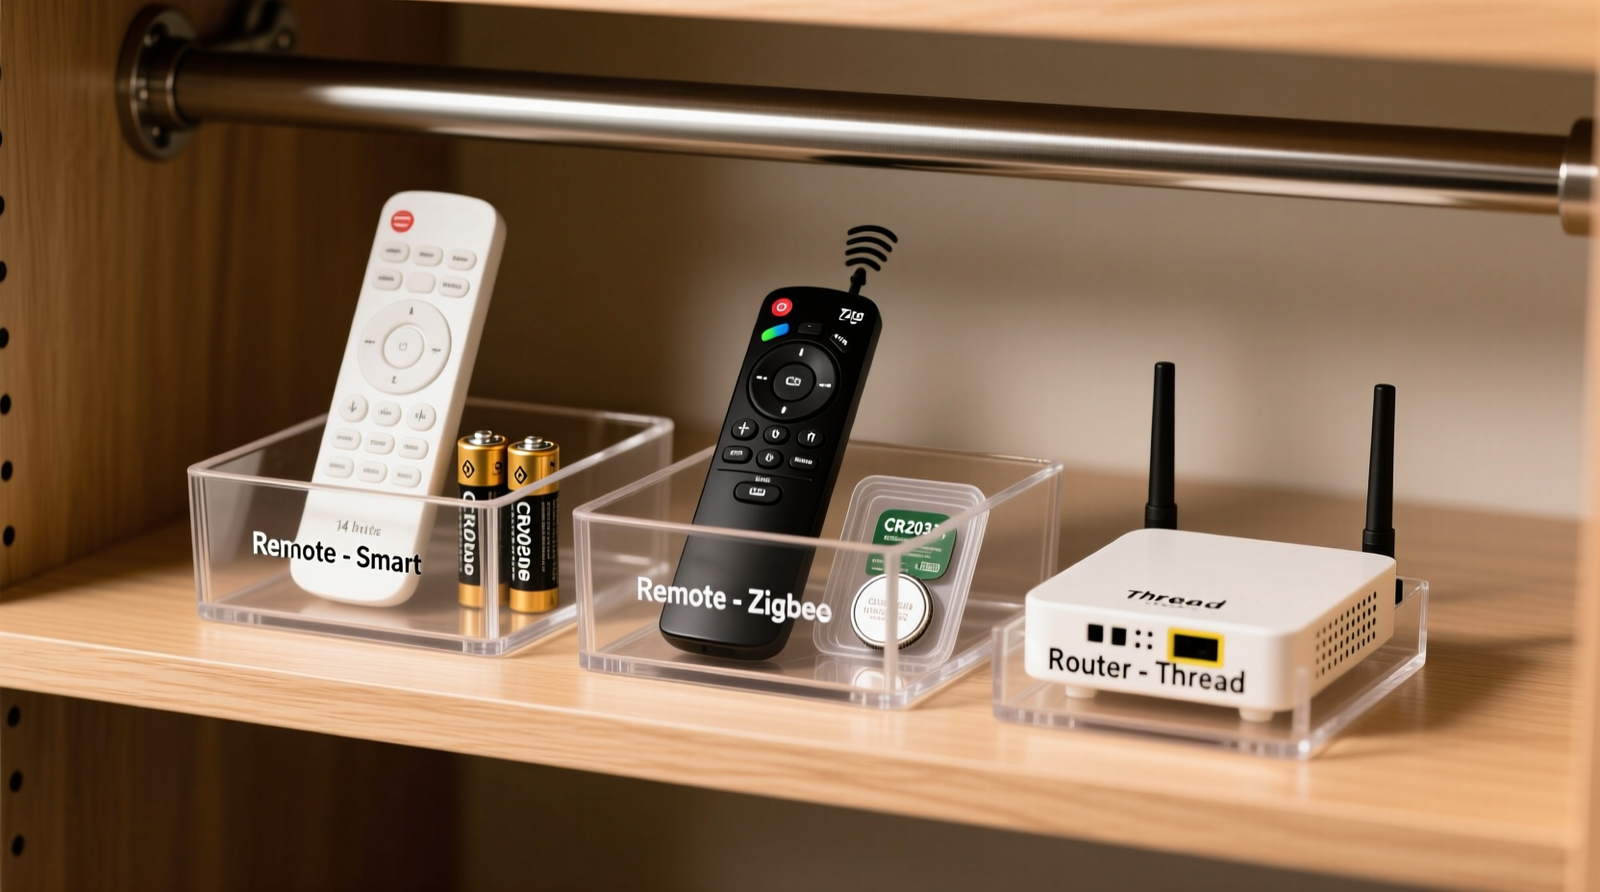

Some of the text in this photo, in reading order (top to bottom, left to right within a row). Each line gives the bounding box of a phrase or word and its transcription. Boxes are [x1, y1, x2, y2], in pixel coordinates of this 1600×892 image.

[252, 530, 336, 564] Remote
[356, 545, 422, 575] Smart
[637, 576, 727, 610] Remote
[1126, 589, 1227, 610] Thread
[1049, 647, 1132, 679] Router
[1155, 660, 1246, 694] Thread
